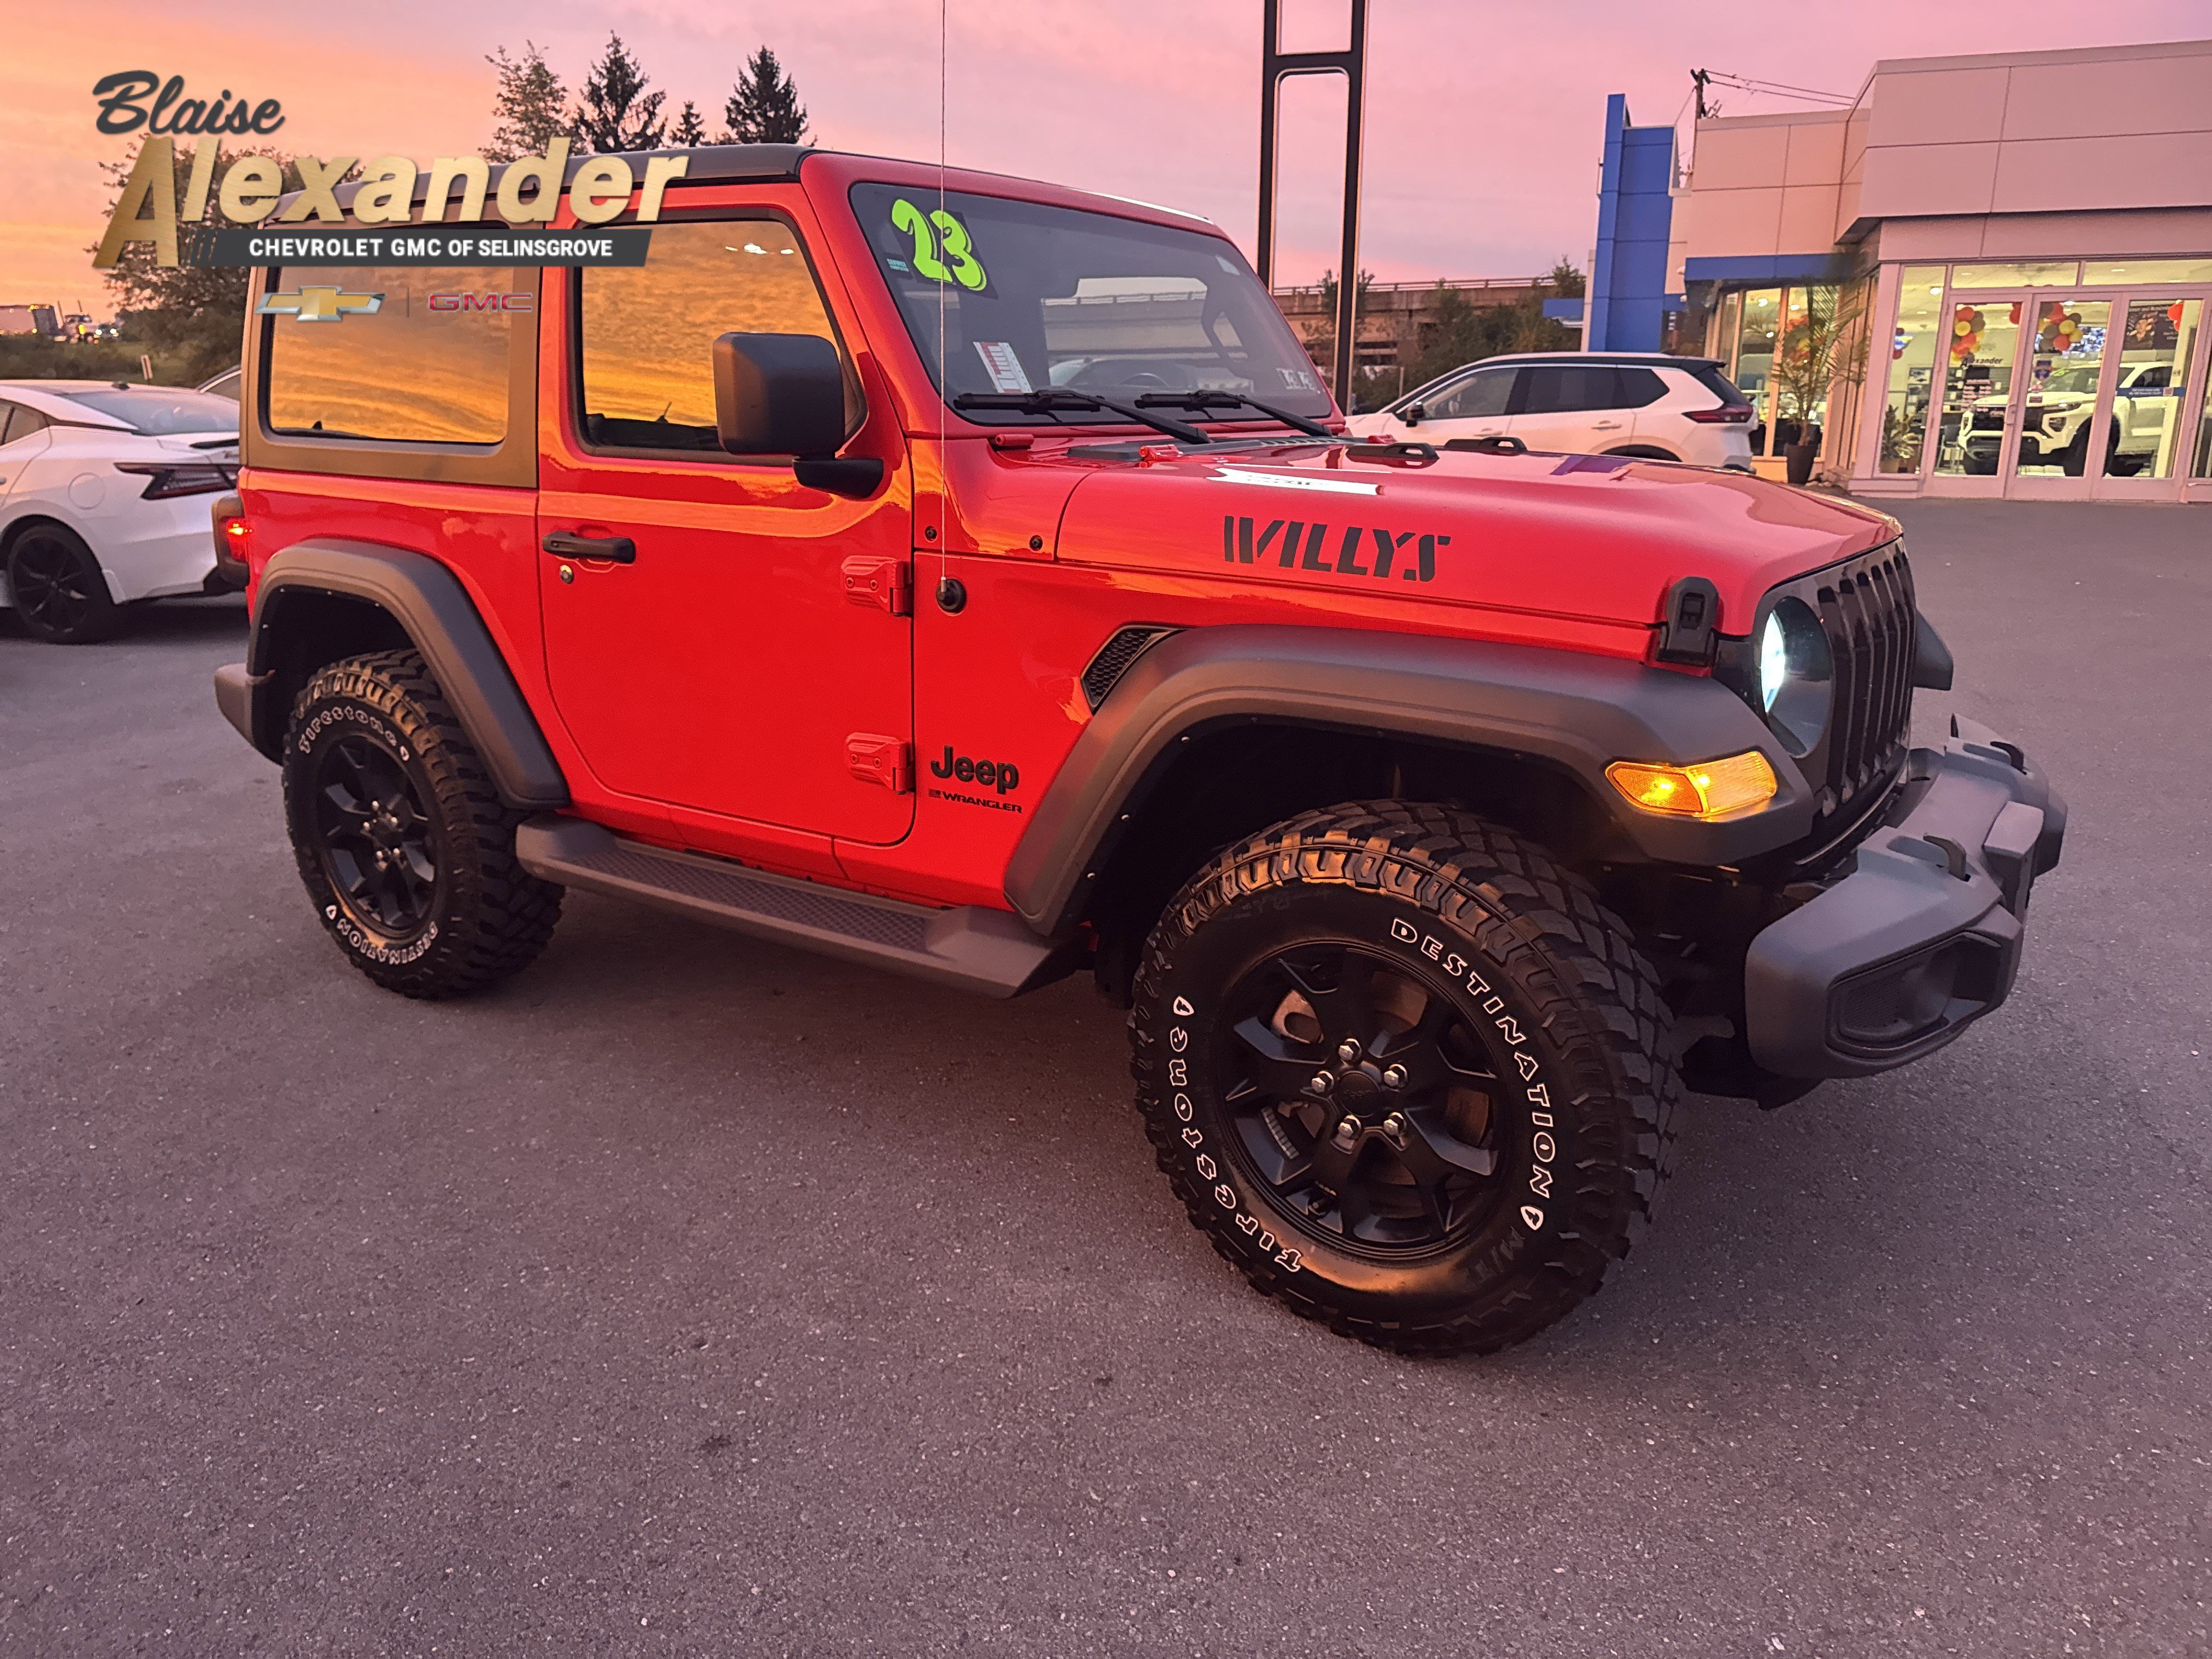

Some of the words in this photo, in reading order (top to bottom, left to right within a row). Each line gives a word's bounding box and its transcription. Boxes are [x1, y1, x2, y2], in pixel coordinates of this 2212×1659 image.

[891, 198, 988, 292] 23
[1223, 515, 1452, 583] WILLYS
[930, 744, 1019, 795] Jeep
[941, 791, 1023, 814] WRANGLER
[1391, 917, 1557, 1199] DESTINATION
